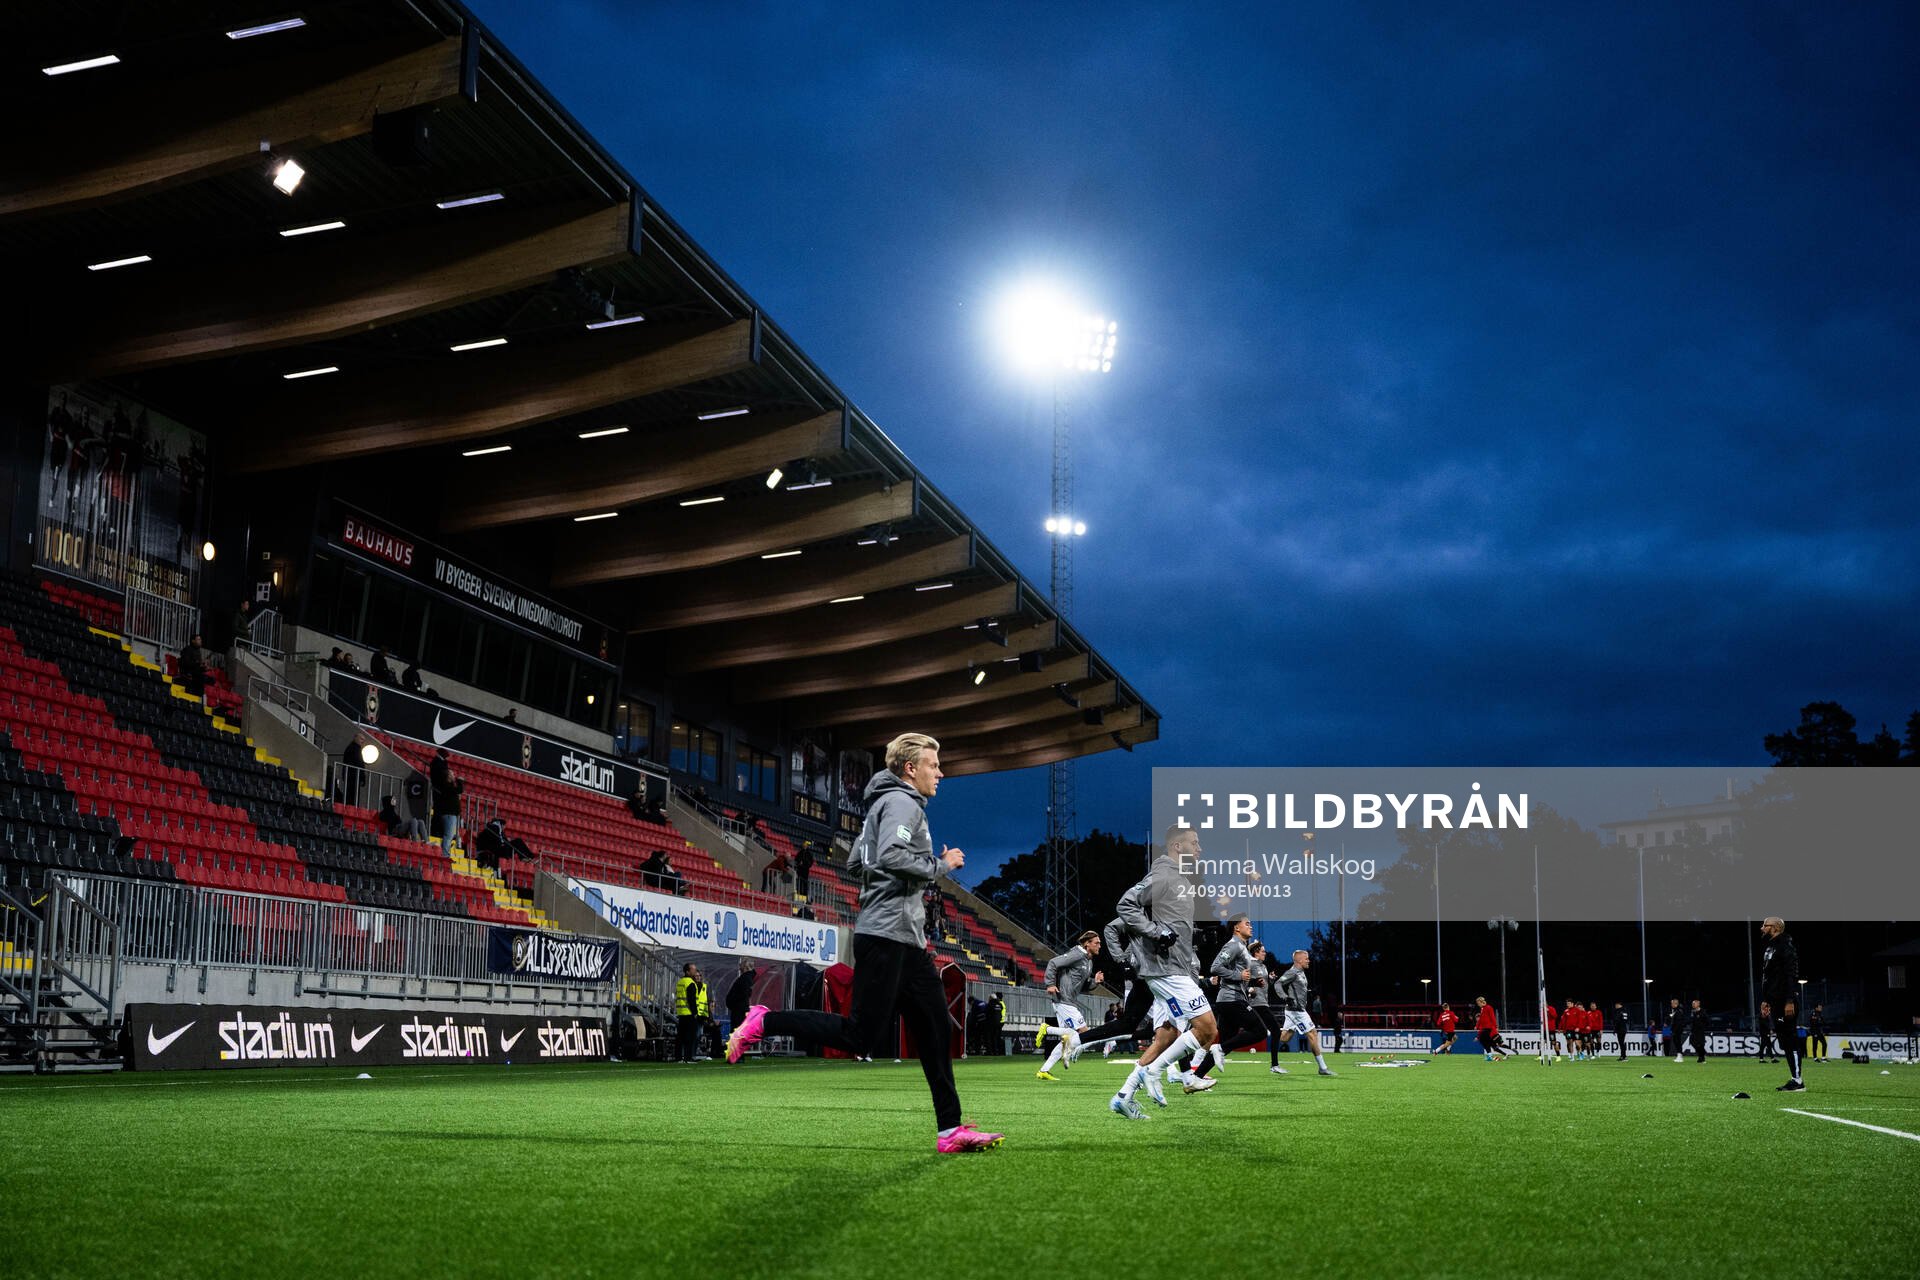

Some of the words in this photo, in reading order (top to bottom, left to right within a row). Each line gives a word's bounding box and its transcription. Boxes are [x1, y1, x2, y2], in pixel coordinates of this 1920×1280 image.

[44, 526, 84, 569] 1000
[345, 519, 413, 566] BAUHAUS
[434, 558, 445, 582] VI
[445, 563, 483, 599] BYGGER
[483, 581, 517, 613] SVENSK
[517, 598, 583, 642] UNGDOMSIDROTT
[560, 751, 615, 793] stadium
[609, 898, 709, 939] bredbandsval.se
[742, 920, 815, 954] bredbandsval.se
[526, 935, 604, 978] ALLSVENSKAN
[218, 1010, 336, 1059] stadium
[400, 1015, 489, 1058] stadium
[538, 1020, 607, 1058] stadium
[1853, 1038, 1908, 1052] weber
